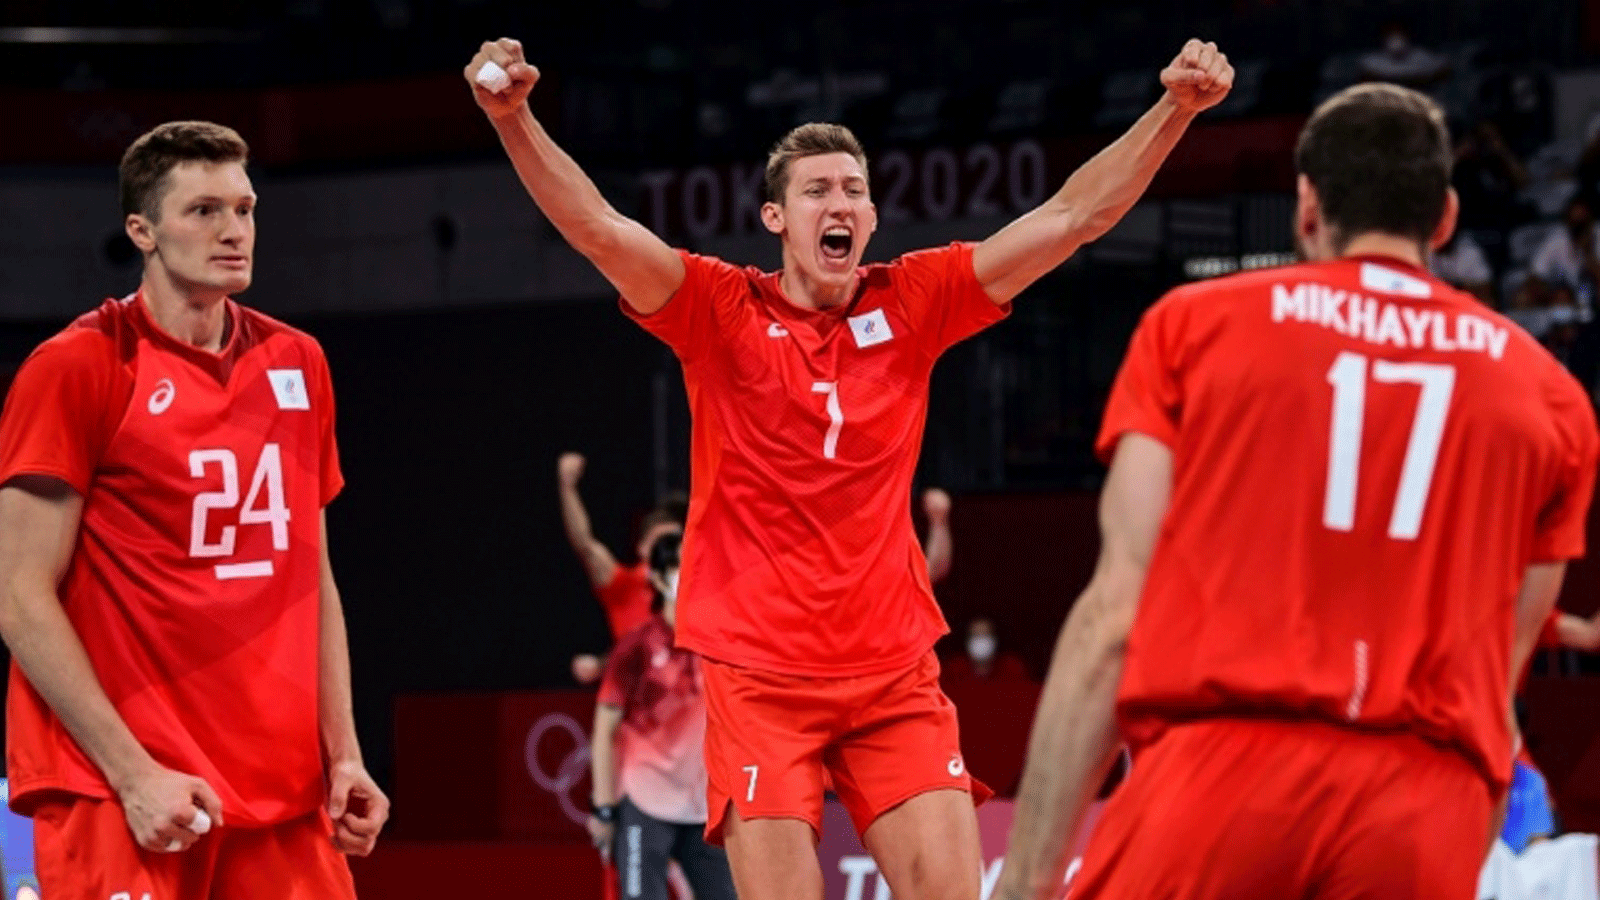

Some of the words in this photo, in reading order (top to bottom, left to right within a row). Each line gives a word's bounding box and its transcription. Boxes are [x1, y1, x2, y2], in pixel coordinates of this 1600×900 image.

[641, 163, 768, 241] TOK
[877, 139, 1047, 222] 2020
[1271, 281, 1508, 360] MIKHAYLOV
[811, 380, 844, 459] 7
[1322, 351, 1456, 540] 17
[188, 442, 291, 558] 24
[742, 765, 759, 802] 7
